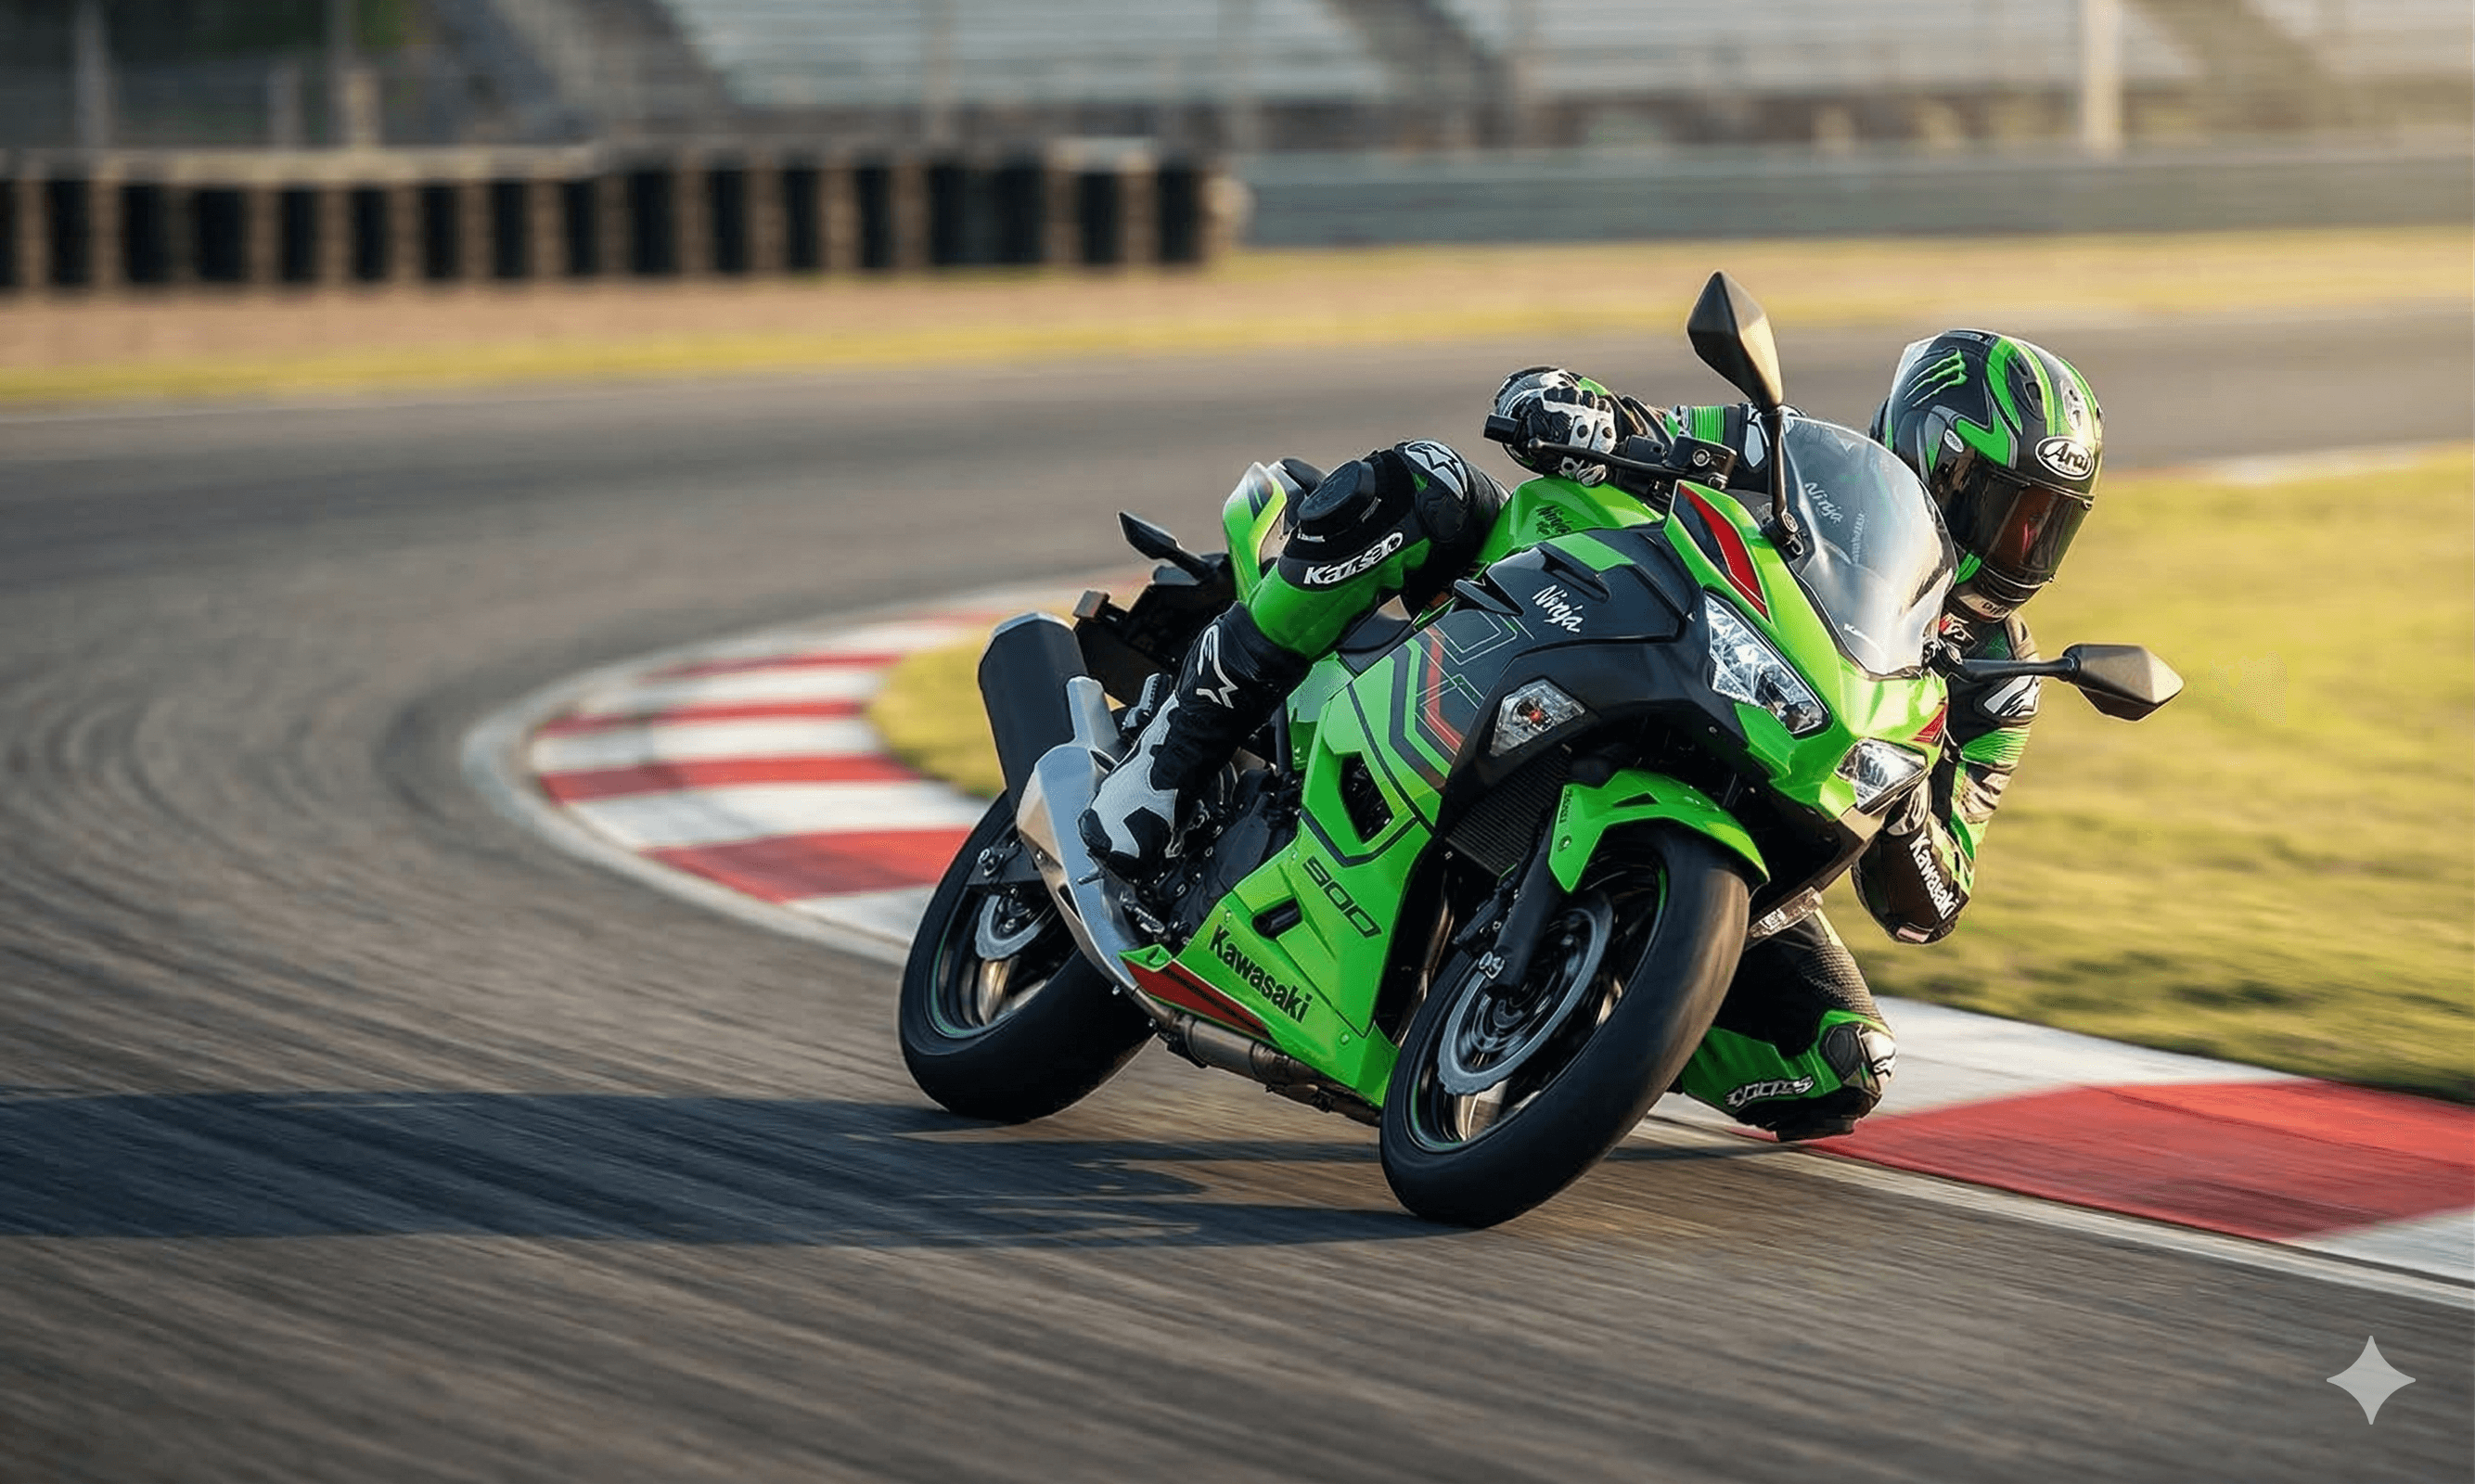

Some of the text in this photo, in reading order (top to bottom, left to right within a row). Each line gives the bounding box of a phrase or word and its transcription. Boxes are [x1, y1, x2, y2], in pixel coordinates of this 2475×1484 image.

[2043, 442, 2089, 471] Arai
[1804, 482, 1843, 524] Ninja
[1532, 584, 1584, 633] Ninja
[1302, 855, 1382, 939] 500
[1909, 830, 1959, 919] Kawasaki
[1210, 925, 1314, 1024] Kawasaki
